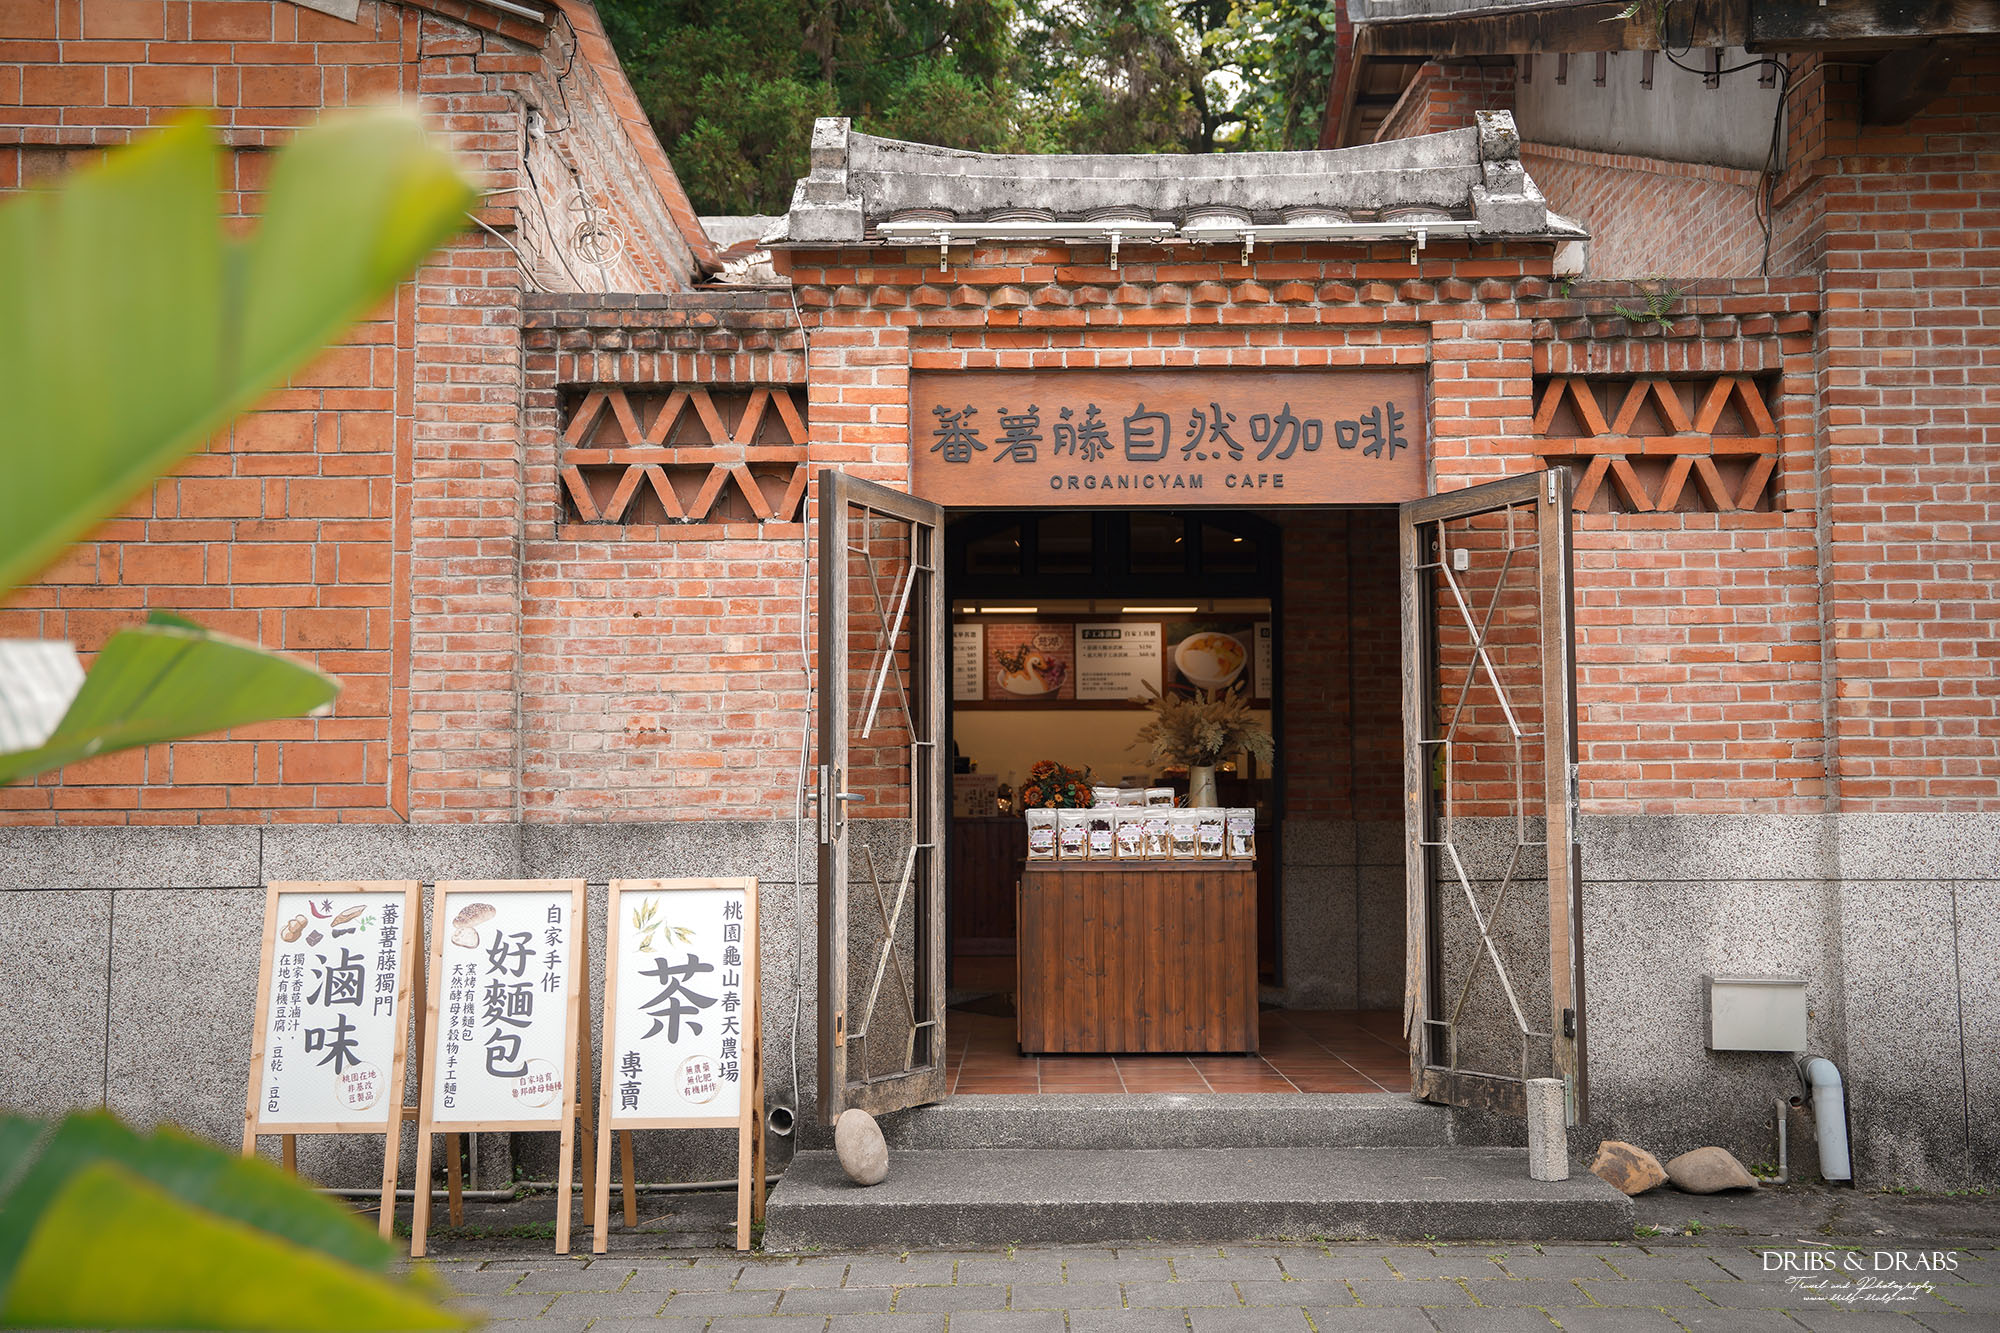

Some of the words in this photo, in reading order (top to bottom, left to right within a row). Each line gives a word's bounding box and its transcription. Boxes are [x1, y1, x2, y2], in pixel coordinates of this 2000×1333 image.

[930, 401, 1409, 463] 蕃薯藤自然咖啡
[1050, 473, 1204, 490] ORGANICYAM
[1225, 473, 1286, 489] CAFE
[373, 904, 399, 1016] 蕃薯藤獨門
[541, 903, 563, 993] 自家手作
[304, 947, 365, 1075] 滷味
[482, 929, 536, 1078] 好麵包
[638, 953, 718, 1044] 茶
[718, 900, 743, 1082] 桃園龜山春天農場
[443, 964, 464, 1108] 天然酵母多穀物手工麵包
[342, 1070, 377, 1083] 桃園在地
[348, 1081, 373, 1093] 非基改
[349, 1091, 374, 1103] 豆製品
[520, 1072, 552, 1086] 自家培育
[619, 1050, 643, 1111] 專賣
[684, 1082, 717, 1096] 有機耕作
[686, 1062, 711, 1075] 無農藥
[687, 1073, 712, 1085] 無化肥
